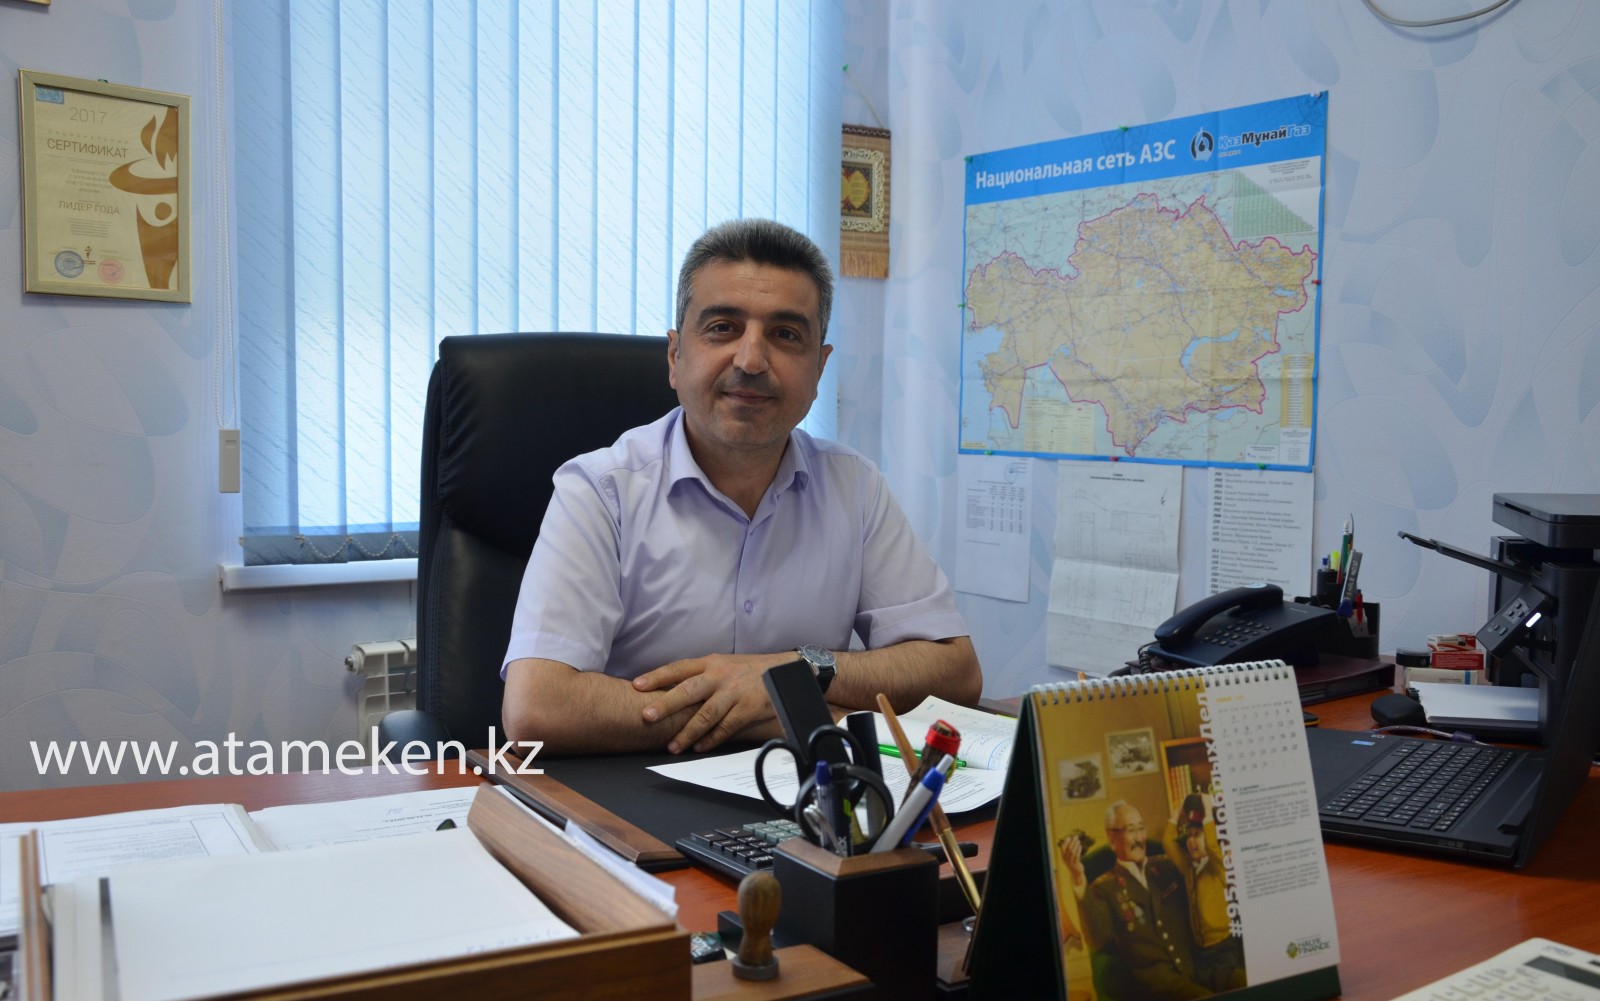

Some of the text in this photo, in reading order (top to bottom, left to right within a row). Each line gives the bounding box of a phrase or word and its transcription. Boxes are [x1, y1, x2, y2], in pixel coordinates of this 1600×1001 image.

[69, 106, 107, 125] 2017
[47, 138, 128, 159] СЕРТИФИКАТ
[975, 139, 1176, 190] Национальная сеть АЗС
[58, 200, 120, 215] ЛИДЕР ГОДА
[1299, 941, 1331, 955] FINANCE
